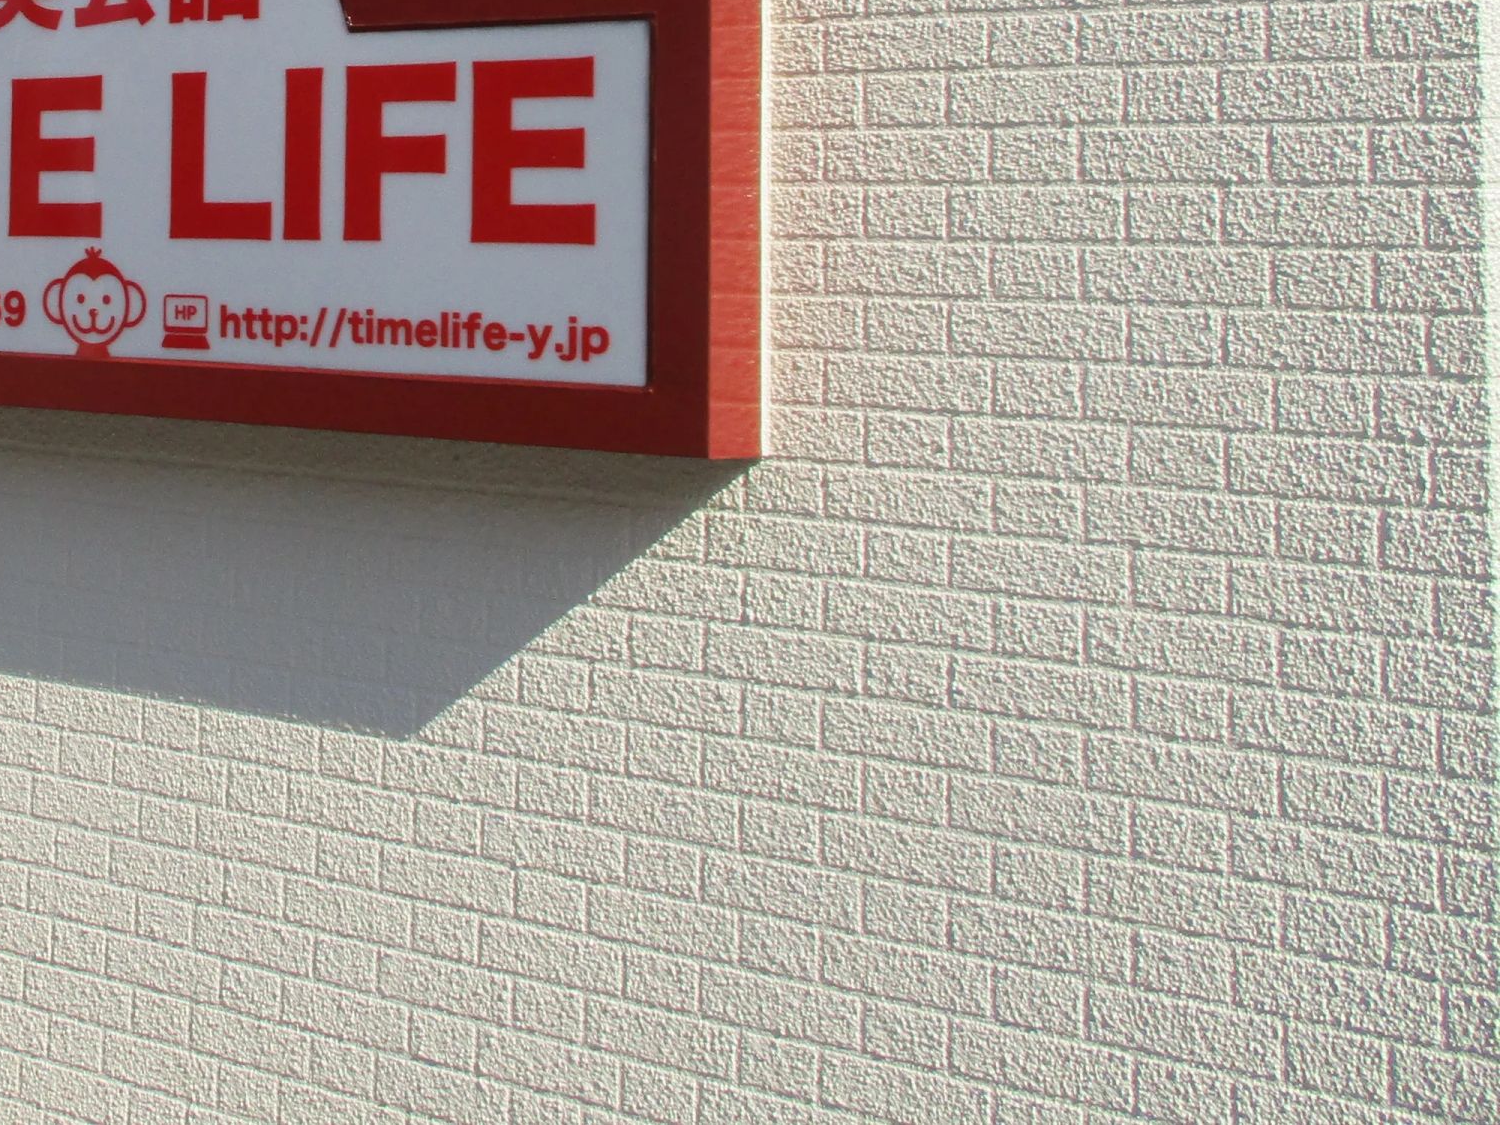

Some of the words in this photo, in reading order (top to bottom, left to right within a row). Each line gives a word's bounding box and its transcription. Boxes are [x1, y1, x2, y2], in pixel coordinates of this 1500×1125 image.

[169, 56, 596, 246] LIFE
[173, 304, 198, 322] HP
[219, 304, 611, 363] http://timelife-y.jp
